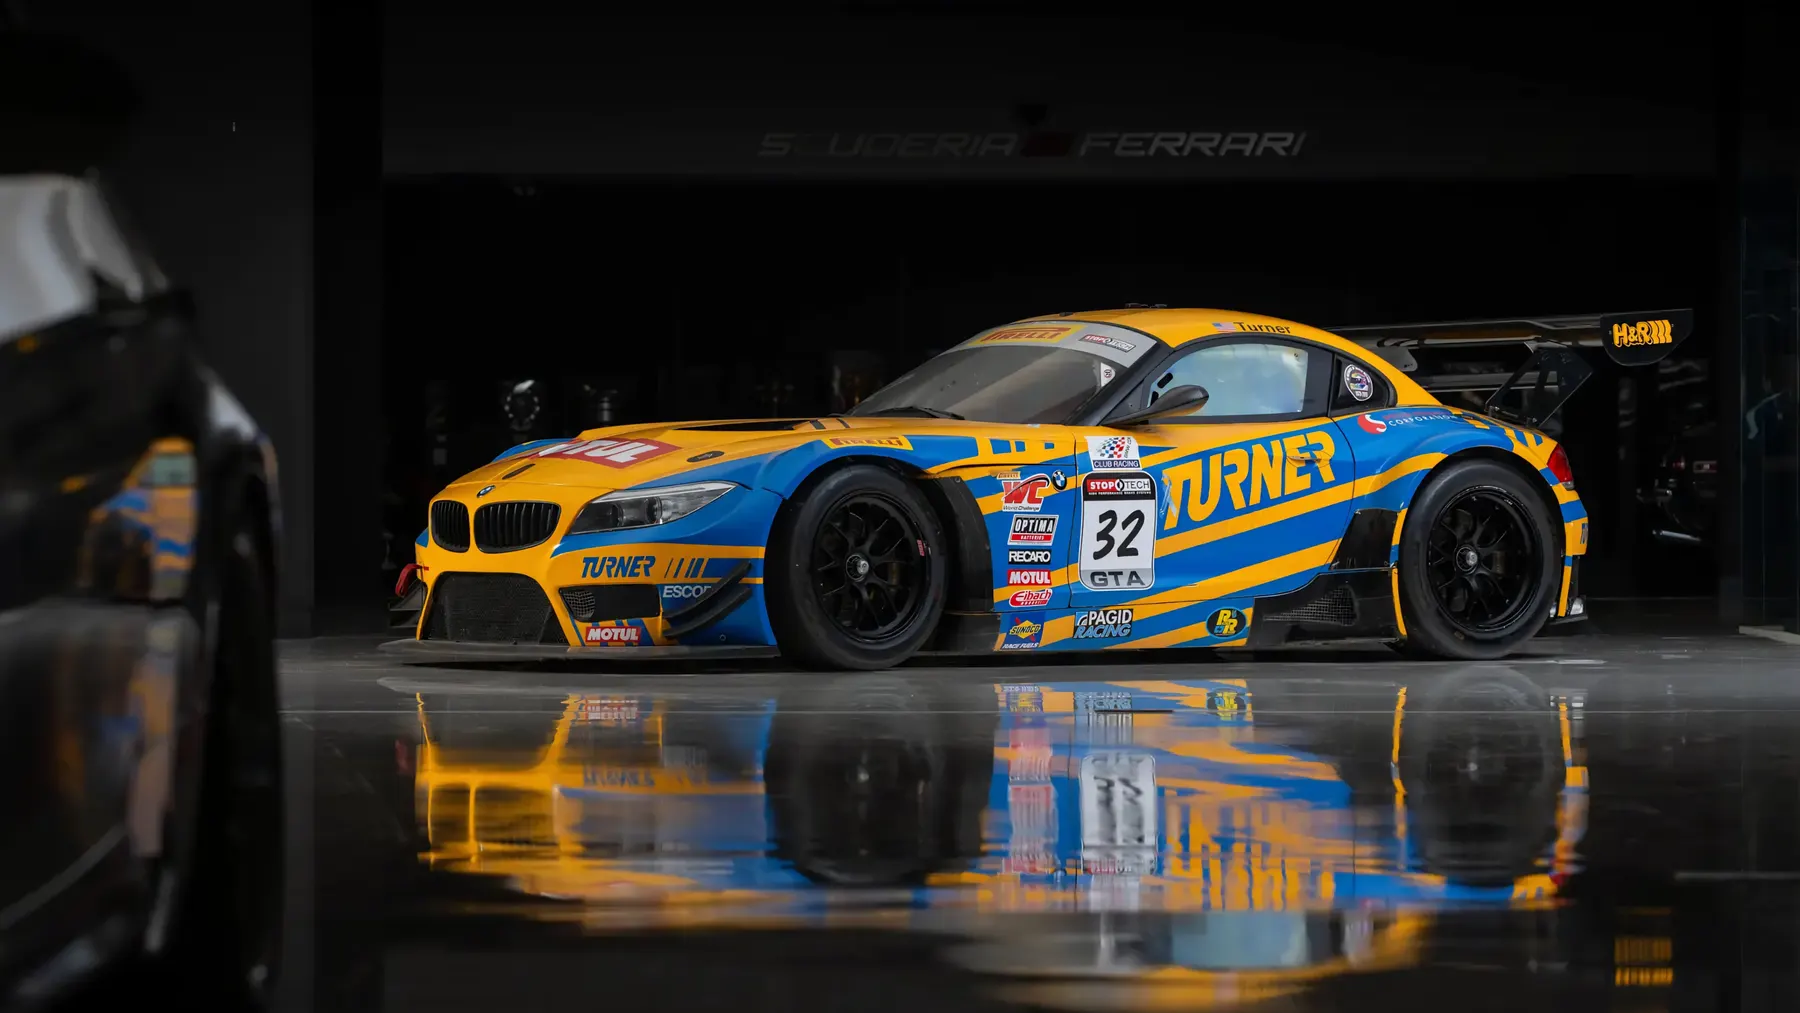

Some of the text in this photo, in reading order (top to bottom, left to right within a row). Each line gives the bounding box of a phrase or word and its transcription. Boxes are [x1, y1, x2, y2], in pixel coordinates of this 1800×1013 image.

[757, 131, 1307, 157] SUDERIA FERRARI
[980, 327, 1071, 342] PIRELLI
[1233, 321, 1291, 334] Turner
[1613, 321, 1653, 347] H&R
[829, 436, 903, 446] PIRELLI
[1094, 460, 1139, 468] CLUB RACING
[1090, 480, 1149, 490] STOP TECH
[1162, 430, 1335, 531] TURNER
[1014, 519, 1053, 533] OPTIMA
[1093, 509, 1145, 560] 32
[1008, 550, 1051, 563] RECARO
[581, 556, 656, 578] TURNER
[1009, 571, 1050, 584] MOTUL
[1090, 570, 1145, 587] GTA
[1010, 589, 1052, 605] Eibach
[1089, 609, 1132, 625] PAGID
[587, 628, 639, 641] MOTUL
[1010, 625, 1041, 634] SUNOCO
[1073, 624, 1131, 639] RACING
